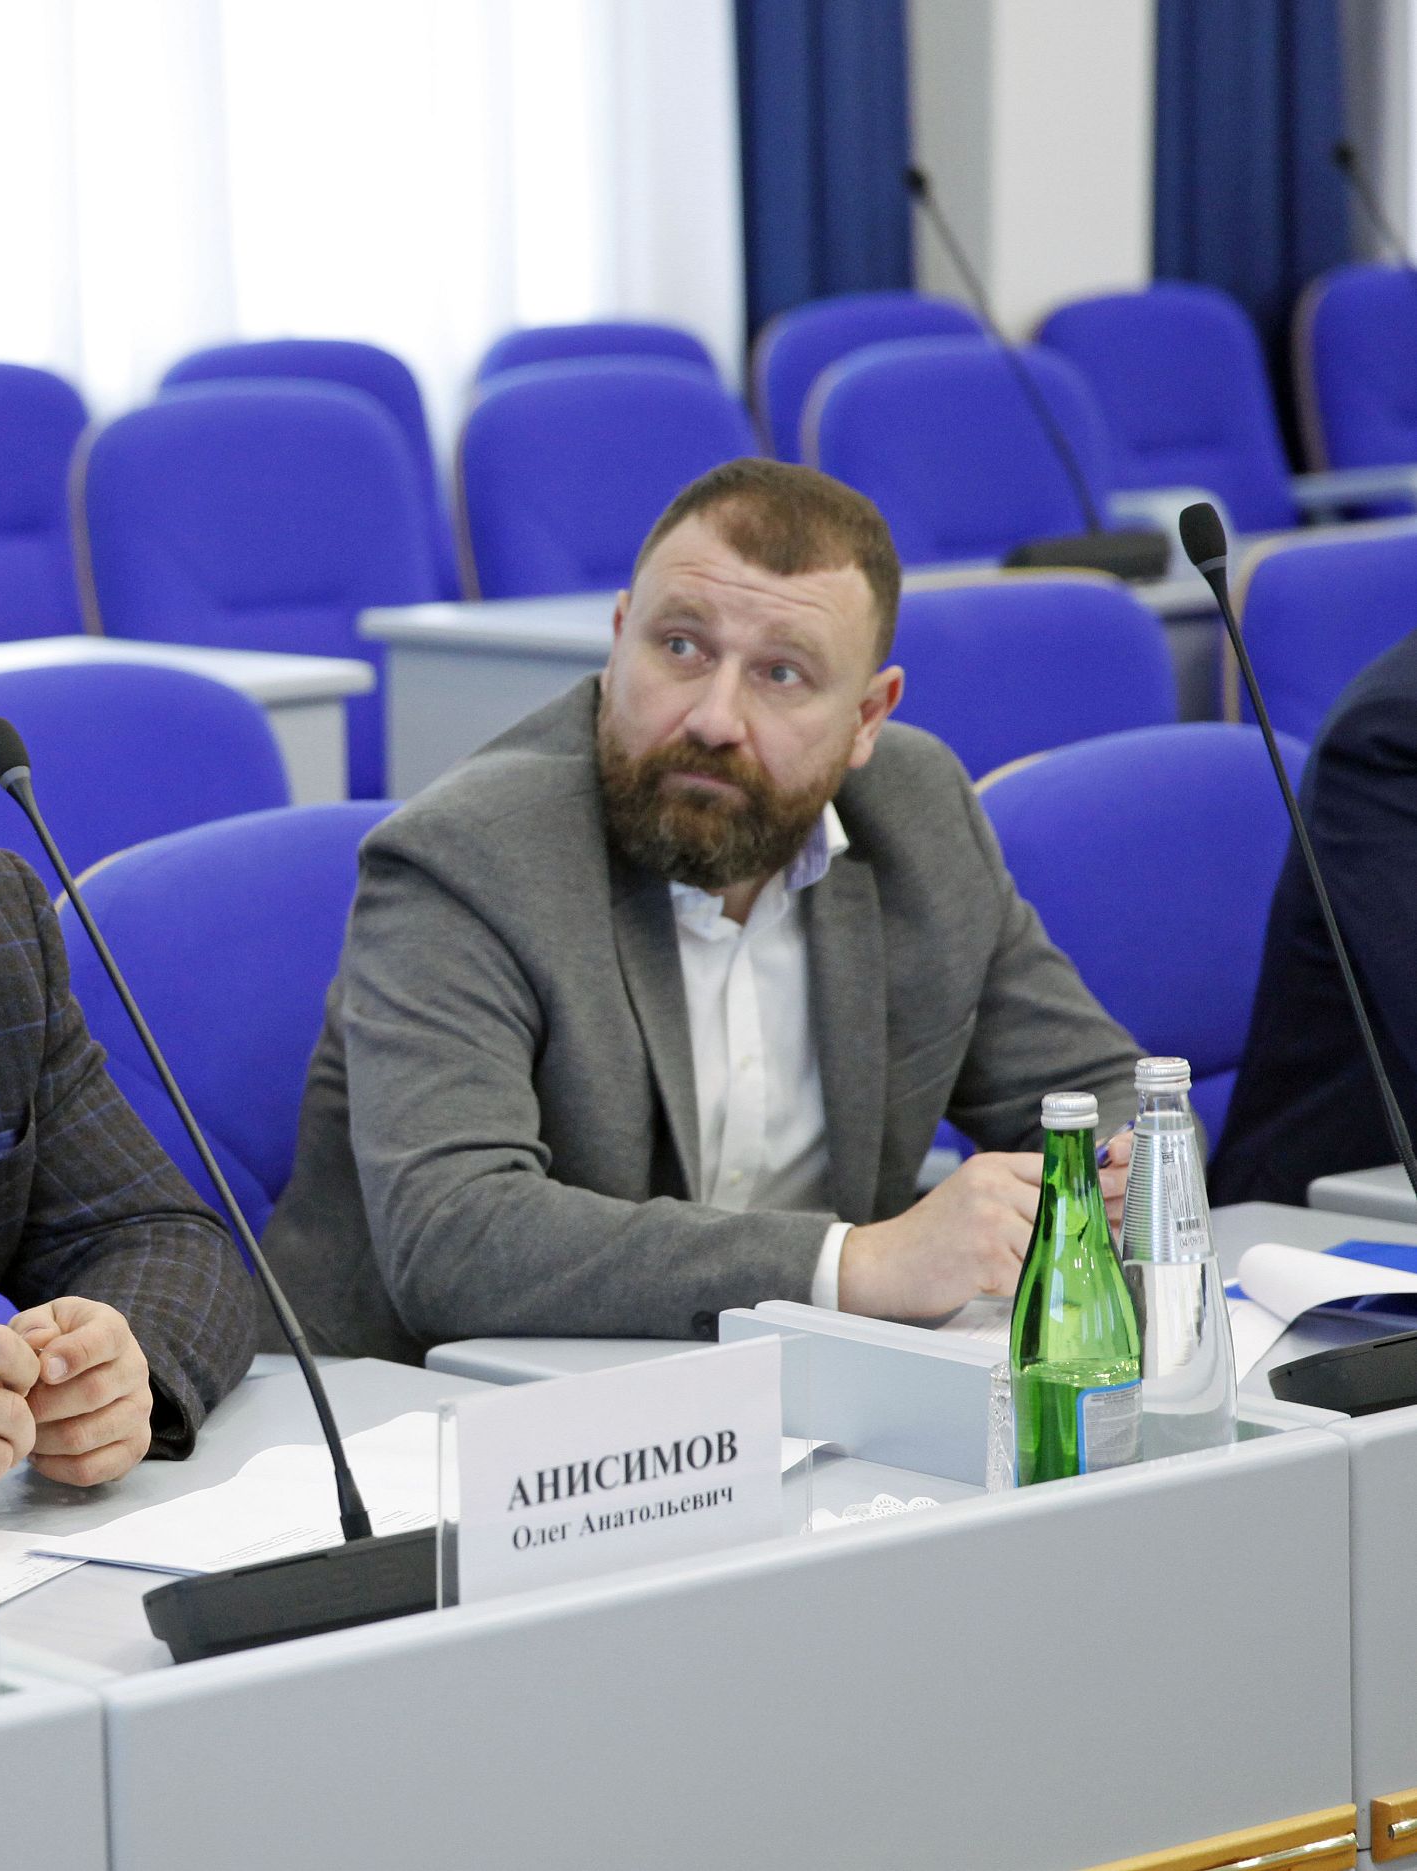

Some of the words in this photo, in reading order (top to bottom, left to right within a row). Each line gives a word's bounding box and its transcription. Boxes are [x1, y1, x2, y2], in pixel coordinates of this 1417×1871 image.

[507, 1430, 738, 1510] АНИСИМОВ
[512, 1519, 569, 1552] Олег
[579, 1487, 734, 1537] Анатольевич
